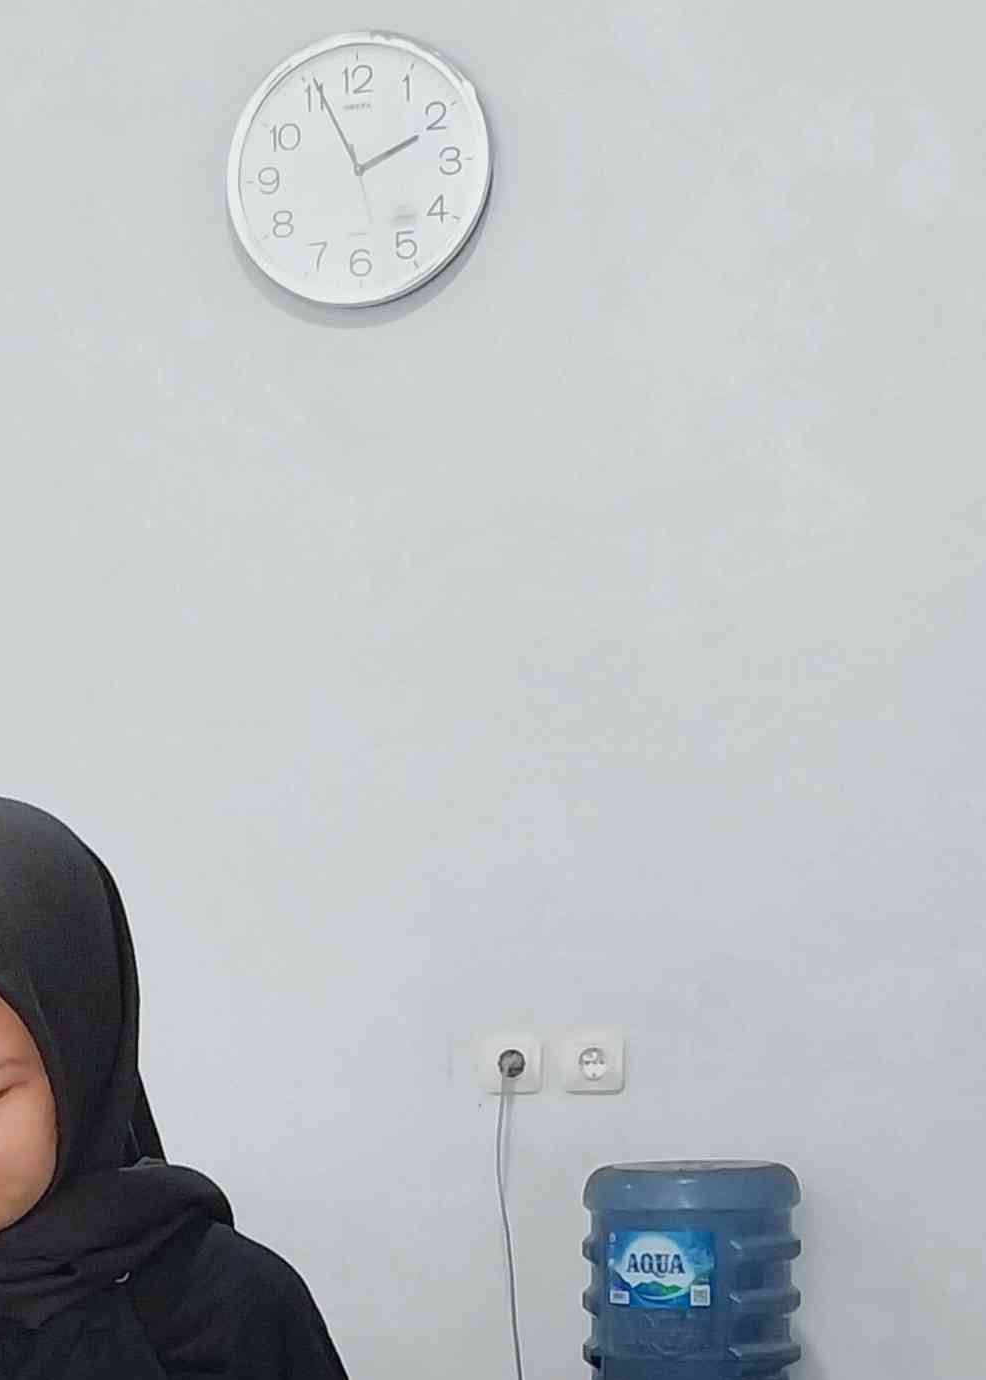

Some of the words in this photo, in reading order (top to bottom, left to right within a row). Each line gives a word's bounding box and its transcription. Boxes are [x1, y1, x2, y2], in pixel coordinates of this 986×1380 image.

[341, 64, 374, 96] 12
[401, 72, 412, 103] 1
[304, 82, 325, 113] 11
[424, 101, 449, 132] 2
[269, 122, 302, 153] 10
[438, 145, 463, 176] 3
[257, 165, 281, 195] 9
[272, 209, 295, 239] 8
[426, 193, 450, 224] 4
[306, 240, 328, 271] 7
[394, 229, 419, 260] 5
[348, 248, 373, 278] 6
[626, 1252, 686, 1279] AQUA
